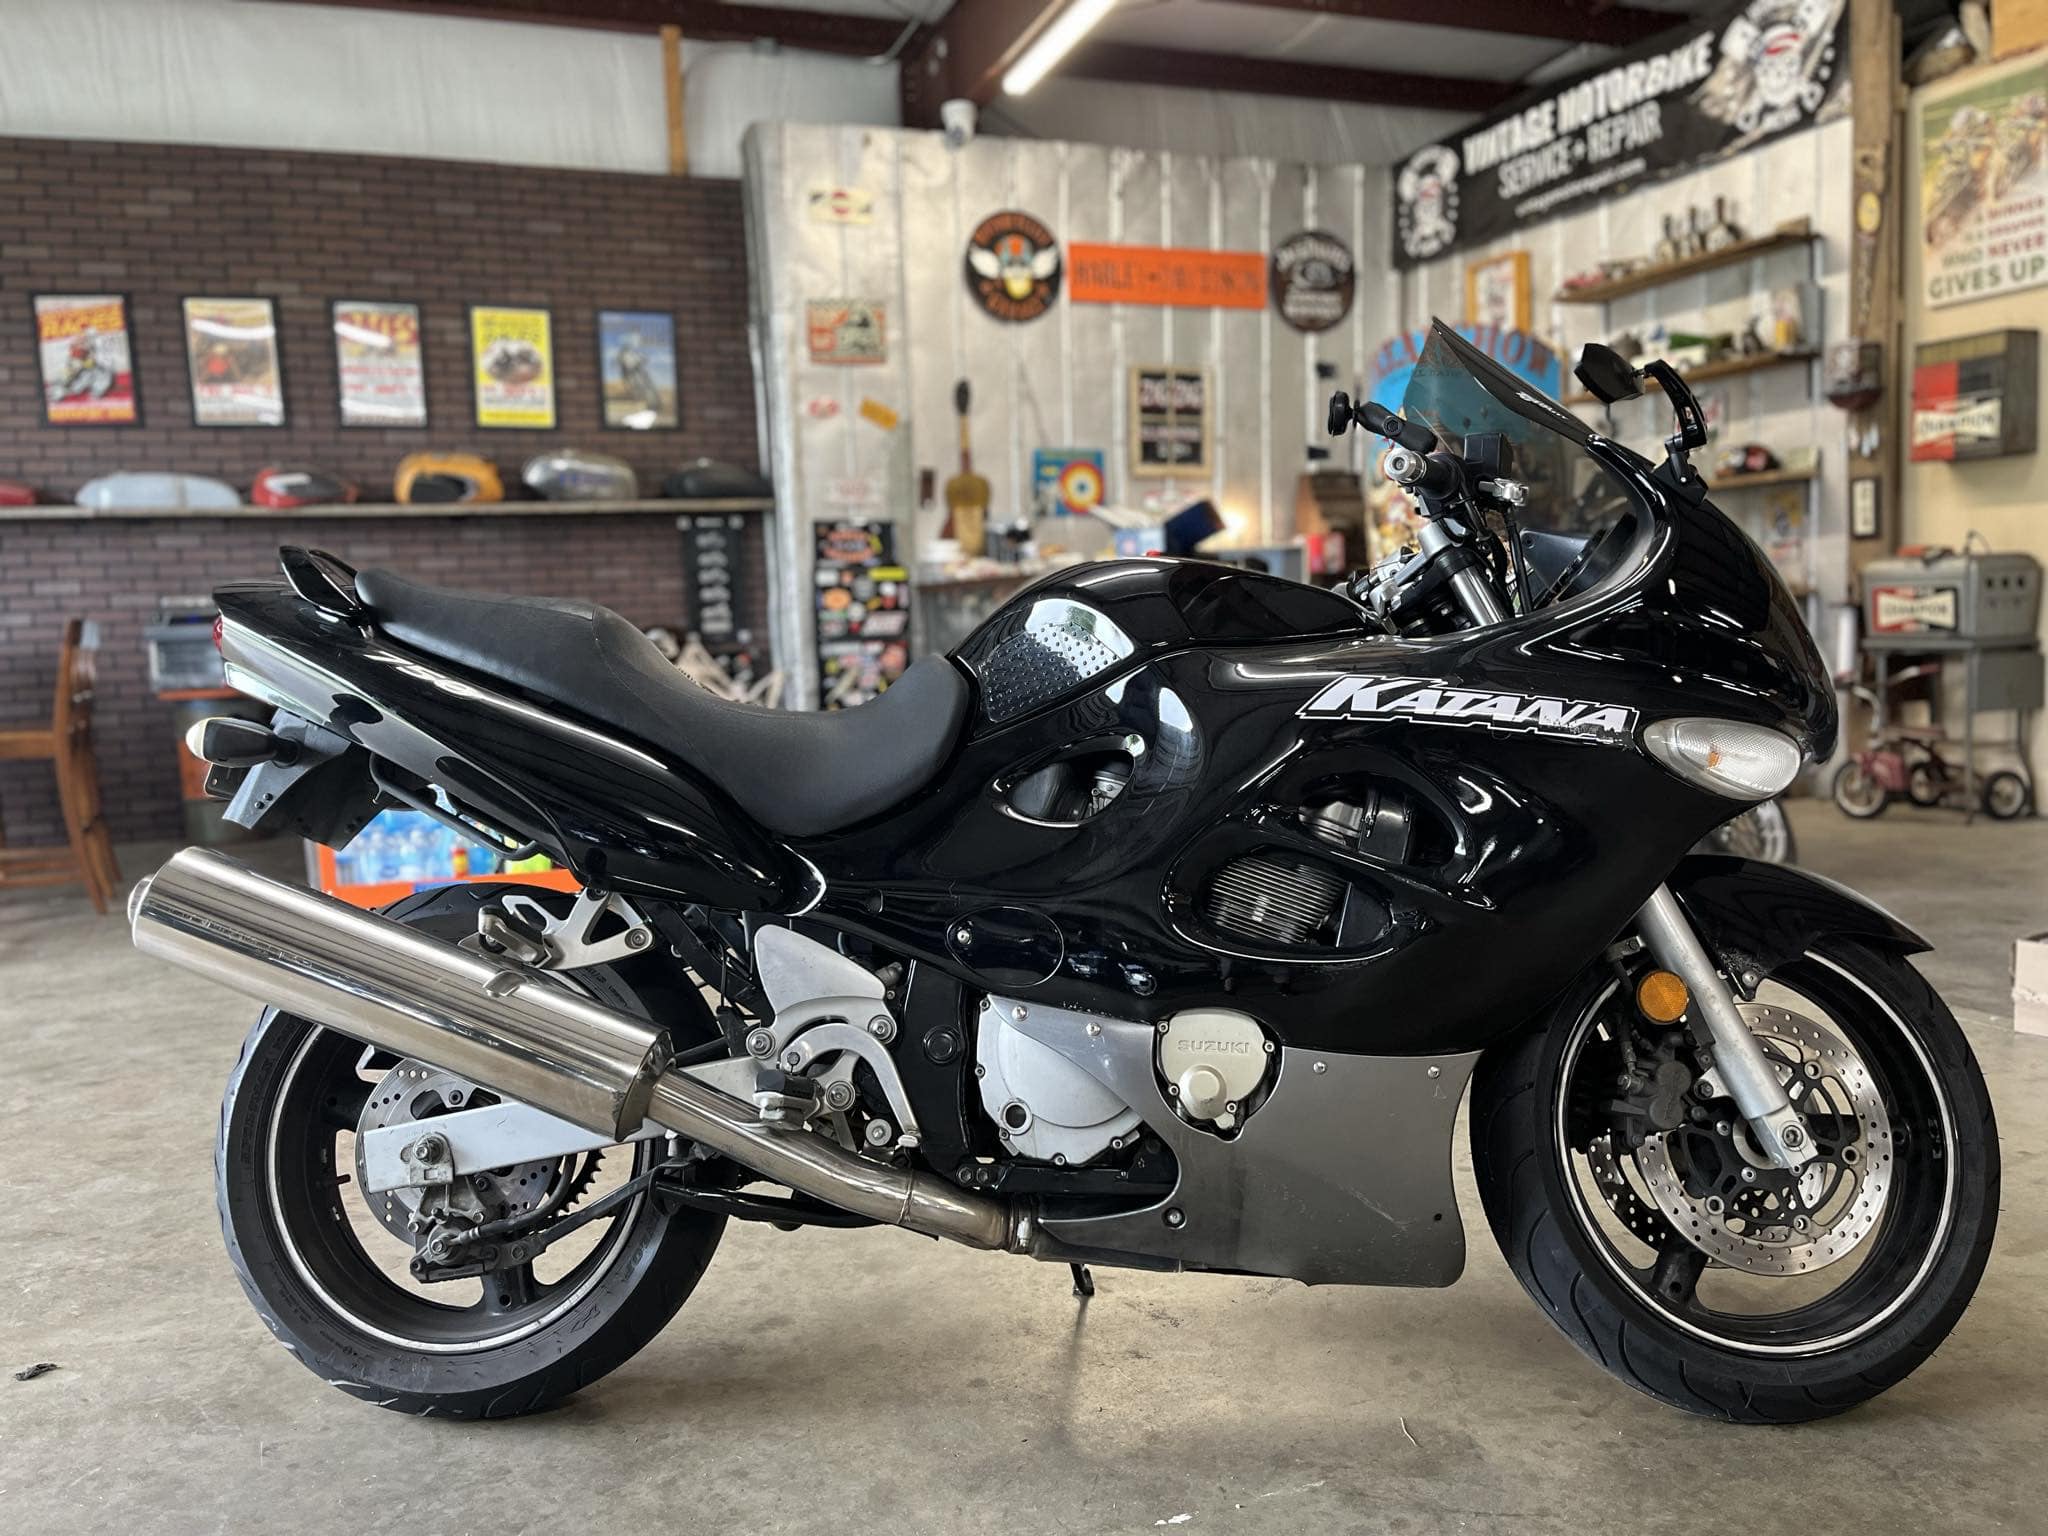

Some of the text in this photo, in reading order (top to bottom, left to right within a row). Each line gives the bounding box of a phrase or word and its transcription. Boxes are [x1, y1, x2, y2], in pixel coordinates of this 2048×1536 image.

[1463, 30, 1716, 176] VINTAGE MOTORBIKE
[1498, 135, 1572, 199] SERVICE
[1586, 99, 1663, 164] REPAIR
[1987, 232, 2045, 257] NEVER
[1928, 253, 2046, 300] GIVES UP
[362, 650, 482, 698] 750
[1300, 676, 1637, 740] KATANA
[1177, 1039, 1250, 1055] SUZUKI
